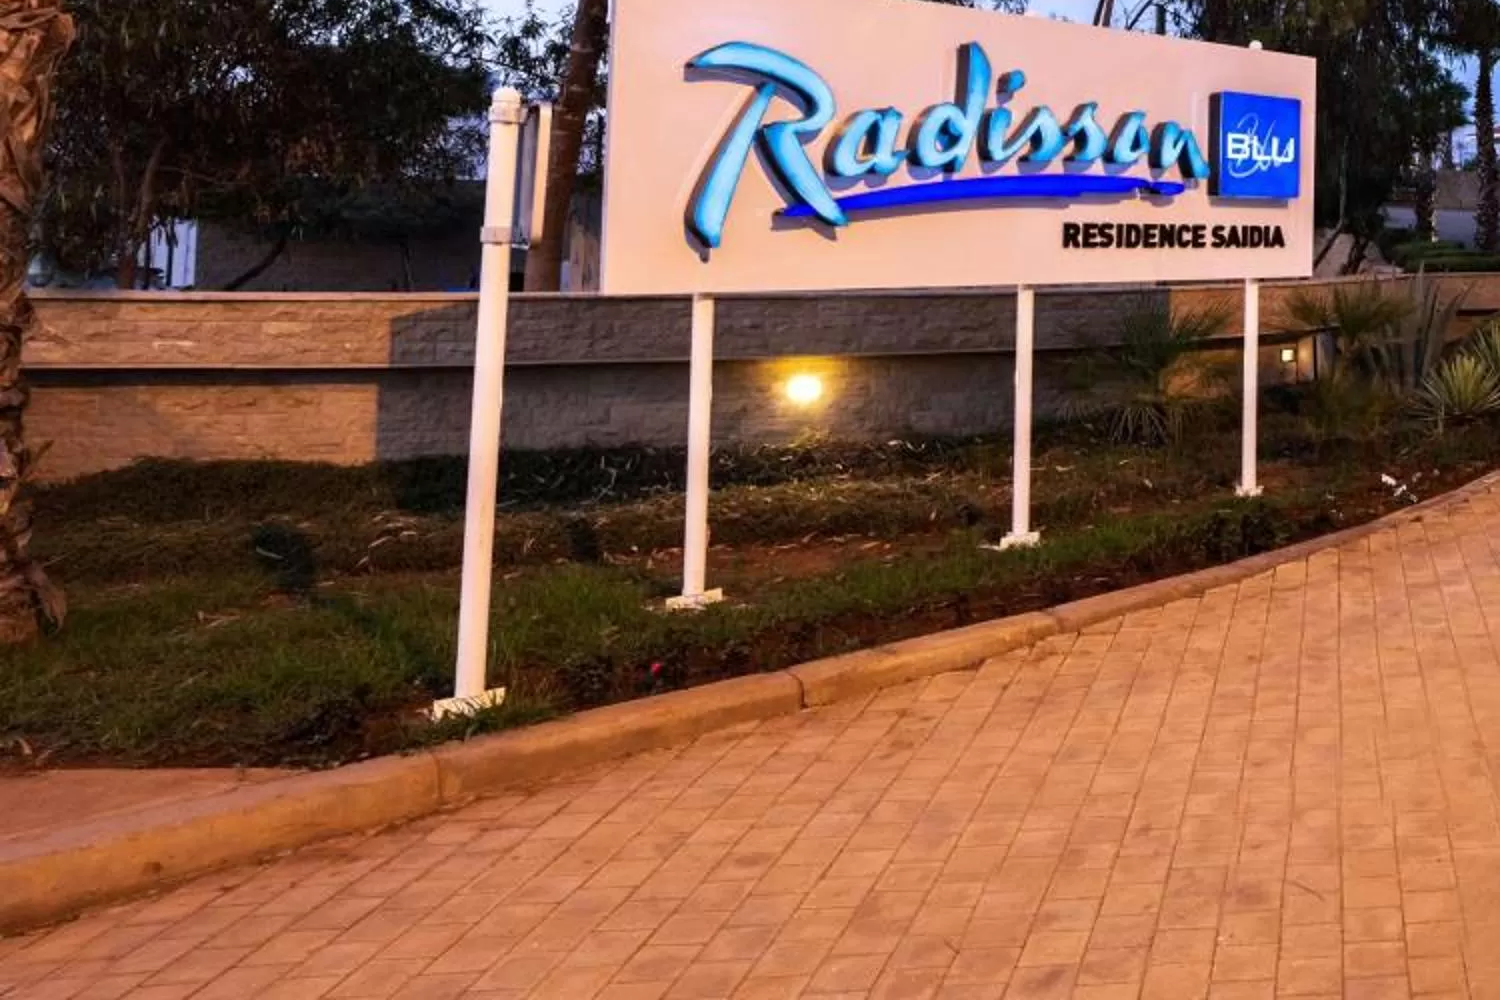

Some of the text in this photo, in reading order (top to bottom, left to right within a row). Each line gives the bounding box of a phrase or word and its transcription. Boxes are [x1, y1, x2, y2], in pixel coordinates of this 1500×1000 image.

[685, 41, 1210, 248] Radisson
[1226, 130, 1295, 165] BLU
[1062, 222, 1285, 248] RESIDENCE SAIDIA
